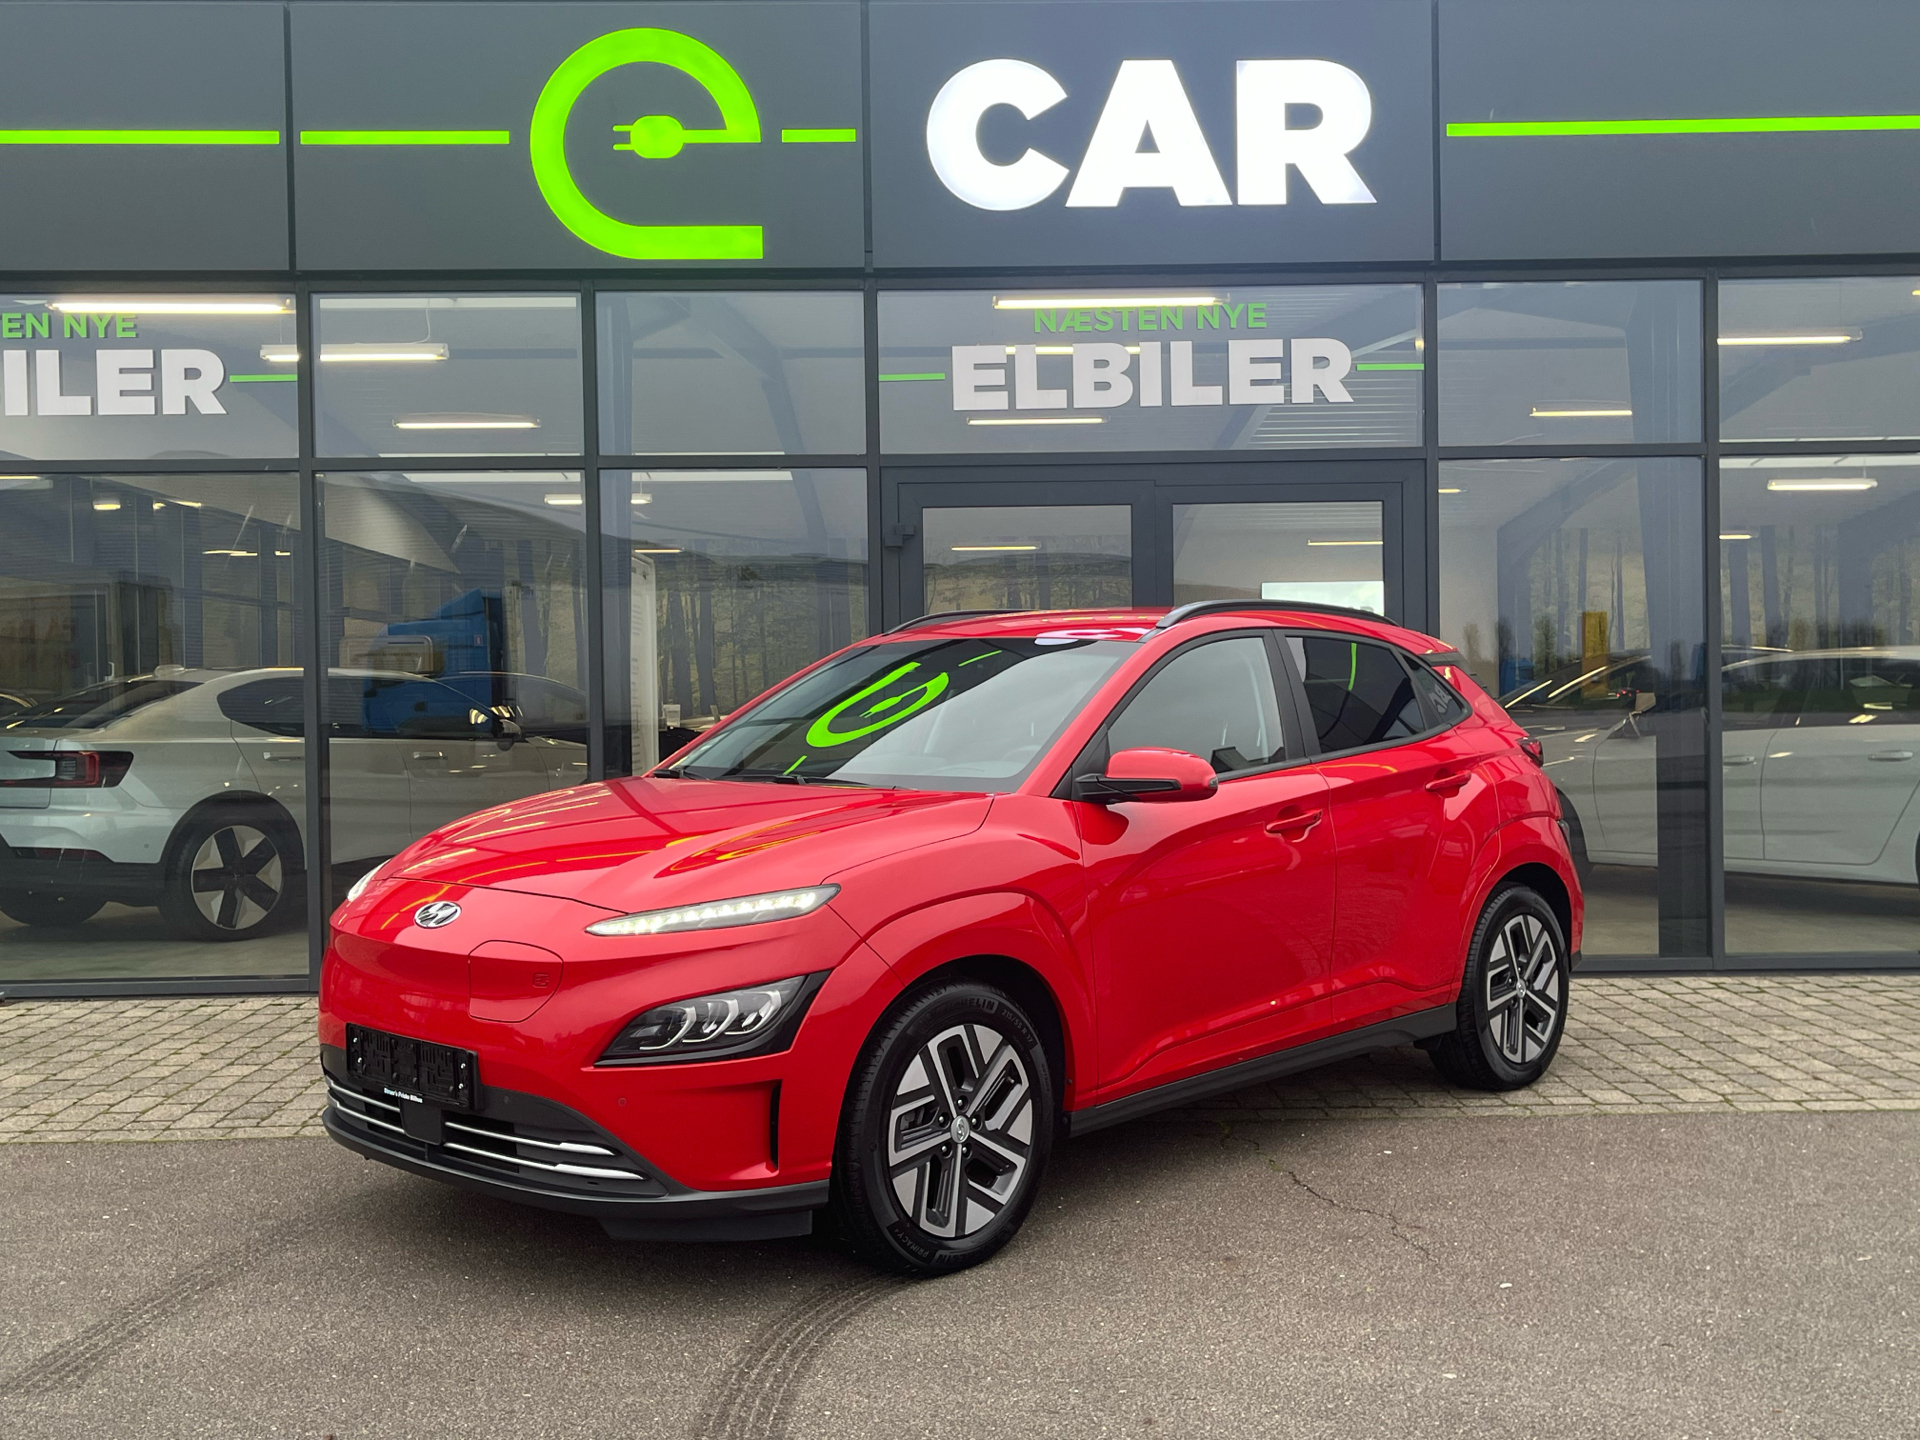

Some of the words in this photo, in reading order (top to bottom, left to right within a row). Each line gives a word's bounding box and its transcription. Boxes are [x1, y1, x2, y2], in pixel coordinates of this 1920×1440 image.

[927, 58, 1377, 211] CAR
[63, 312, 137, 338] NYE
[1034, 304, 1183, 332] NÆSTEN
[1197, 303, 1267, 329] NYE
[952, 337, 1354, 411] ELBILER
[1001, 1008, 1022, 1029] 215/55
[896, 1231, 930, 1258] PRIMACY
